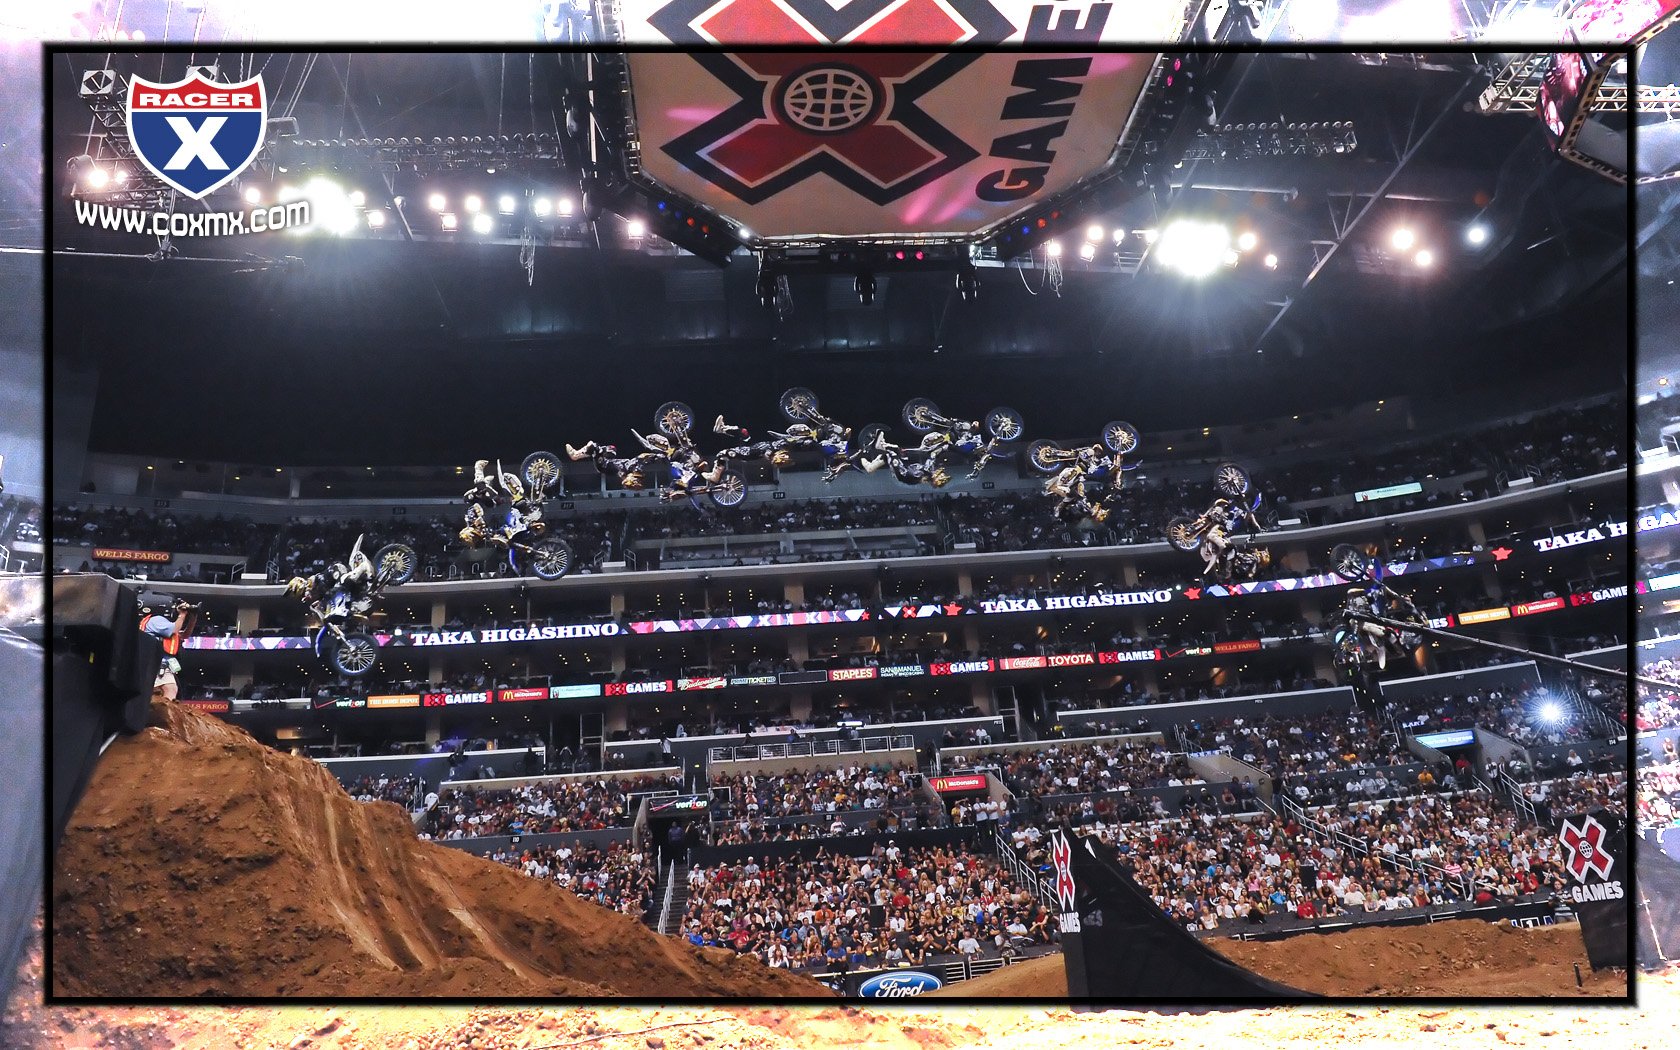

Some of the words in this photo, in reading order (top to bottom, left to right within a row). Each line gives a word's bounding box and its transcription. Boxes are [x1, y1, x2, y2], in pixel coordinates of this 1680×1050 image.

[975, 0, 1113, 203] GAME
[1534, 527, 1606, 552] TAKA
[95, 550, 132, 559] WELLS
[133, 552, 170, 561] FARGO
[1592, 585, 1628, 601] GAME
[980, 599, 1041, 614] TAKA
[1046, 589, 1172, 610] HIGASHINO
[410, 631, 476, 646] TAKA
[481, 622, 620, 643] HIGASHINO
[1117, 650, 1156, 662] GAMES
[1185, 647, 1212, 655] verizon
[1047, 654, 1095, 666] TOYOTA
[898, 665, 924, 673] MANUEL
[950, 661, 989, 673] GAMES
[832, 668, 873, 680] STAPLES
[625, 682, 667, 694] GAMES
[680, 677, 722, 690] Budweiser
[335, 699, 366, 708] verizon
[445, 692, 487, 704] GAMES
[948, 779, 979, 787] McDonald's
[675, 799, 708, 810] verizon
[1571, 880, 1624, 903] GAMES
[875, 977, 924, 998] Ford
